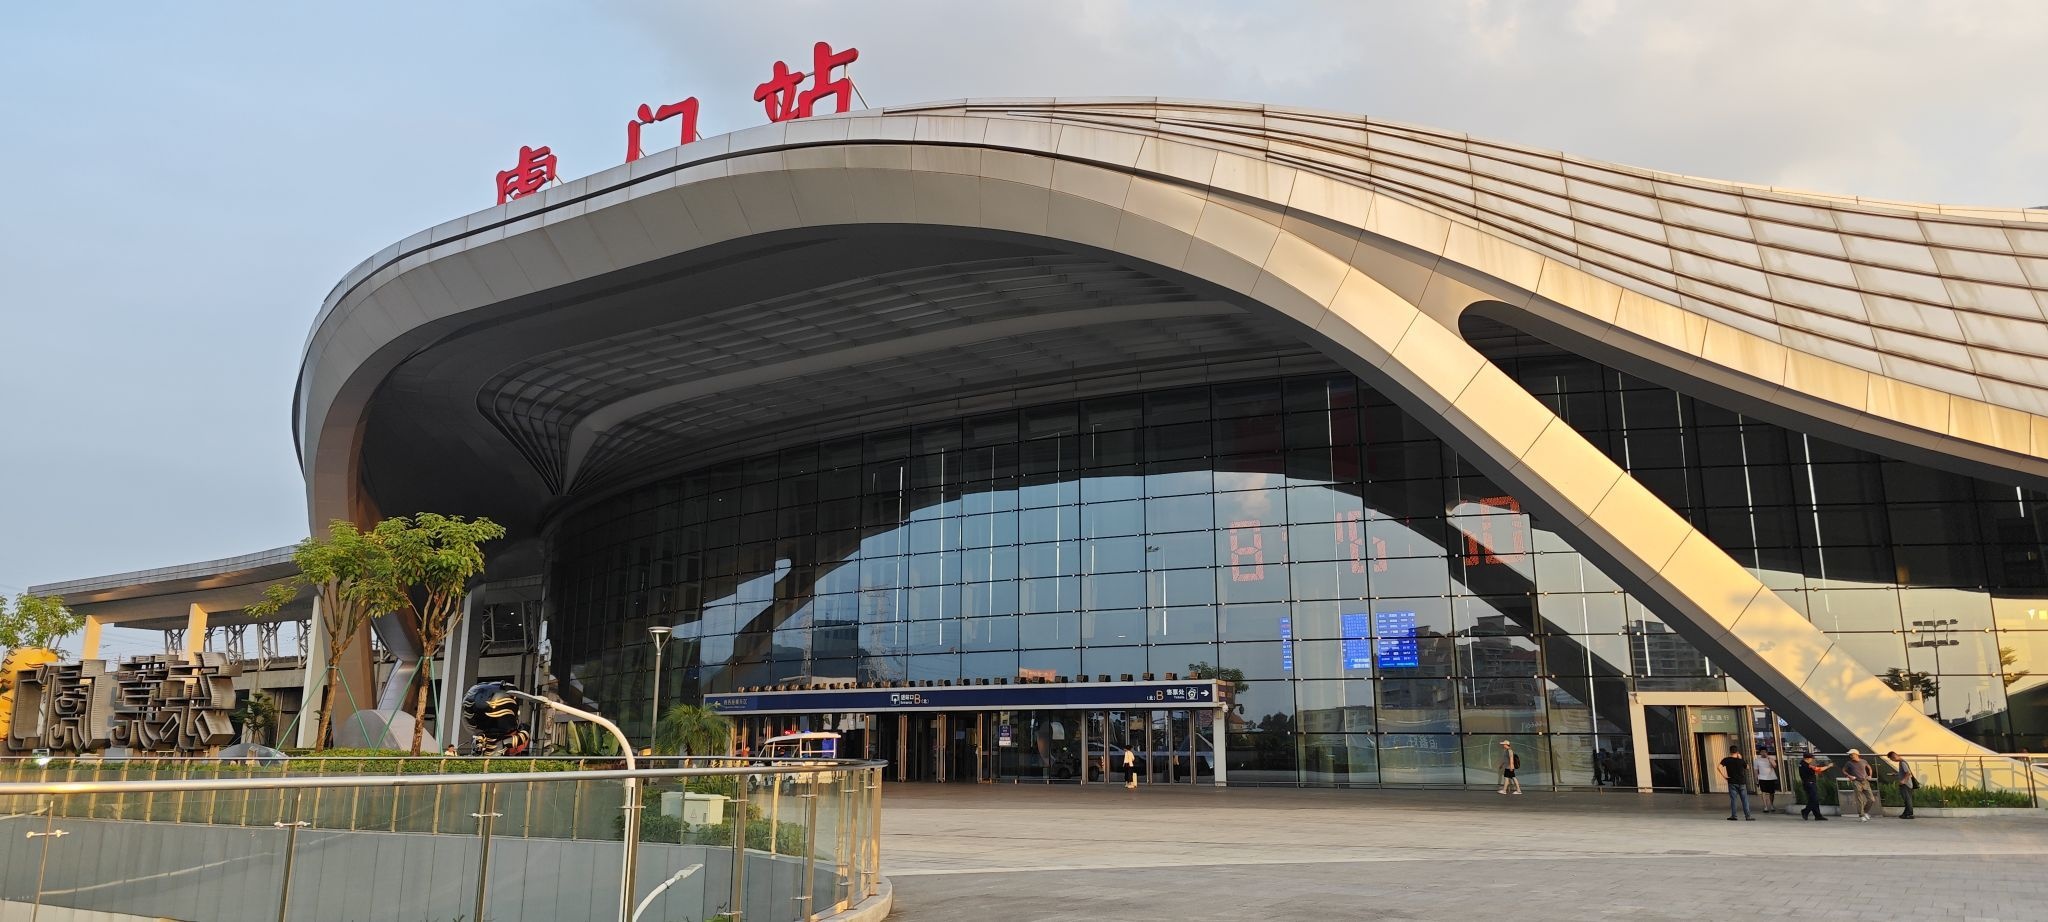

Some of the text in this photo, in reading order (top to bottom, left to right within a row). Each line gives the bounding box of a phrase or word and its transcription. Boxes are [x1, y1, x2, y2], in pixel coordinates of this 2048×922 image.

[497, 41, 859, 205] 虎门站
[914, 694, 920, 704] B
[1156, 690, 1164, 700] B
